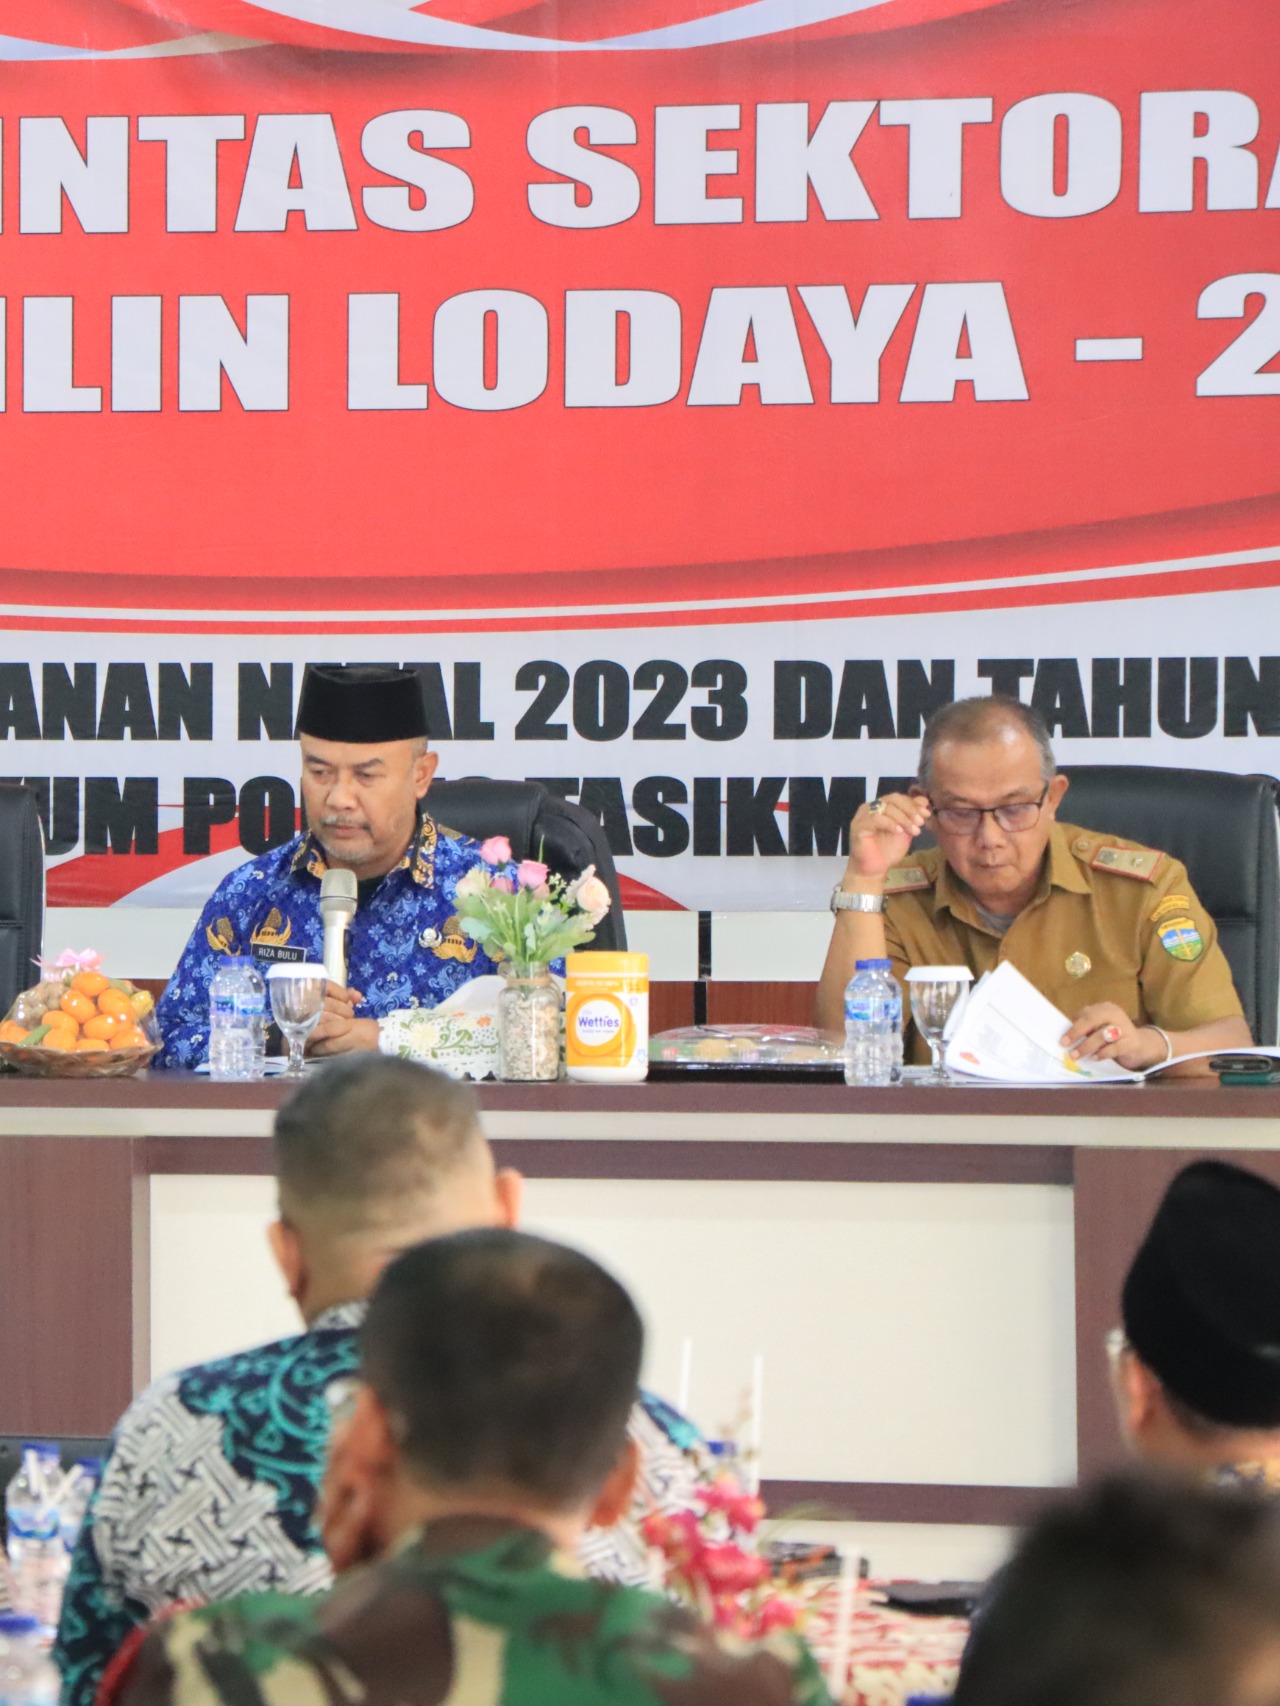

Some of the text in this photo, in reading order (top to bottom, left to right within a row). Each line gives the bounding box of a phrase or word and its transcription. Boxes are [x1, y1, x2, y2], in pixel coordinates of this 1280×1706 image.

[525, 90, 1280, 230] SEKTOR
[347, 281, 1031, 412] LODAYA
[515, 659, 748, 742] 2023
[773, 659, 955, 740] DAN
[977, 656, 1280, 740] TAHUN
[258, 947, 298, 960] RIZA BULU
[578, 1015, 620, 1028] Wetties
